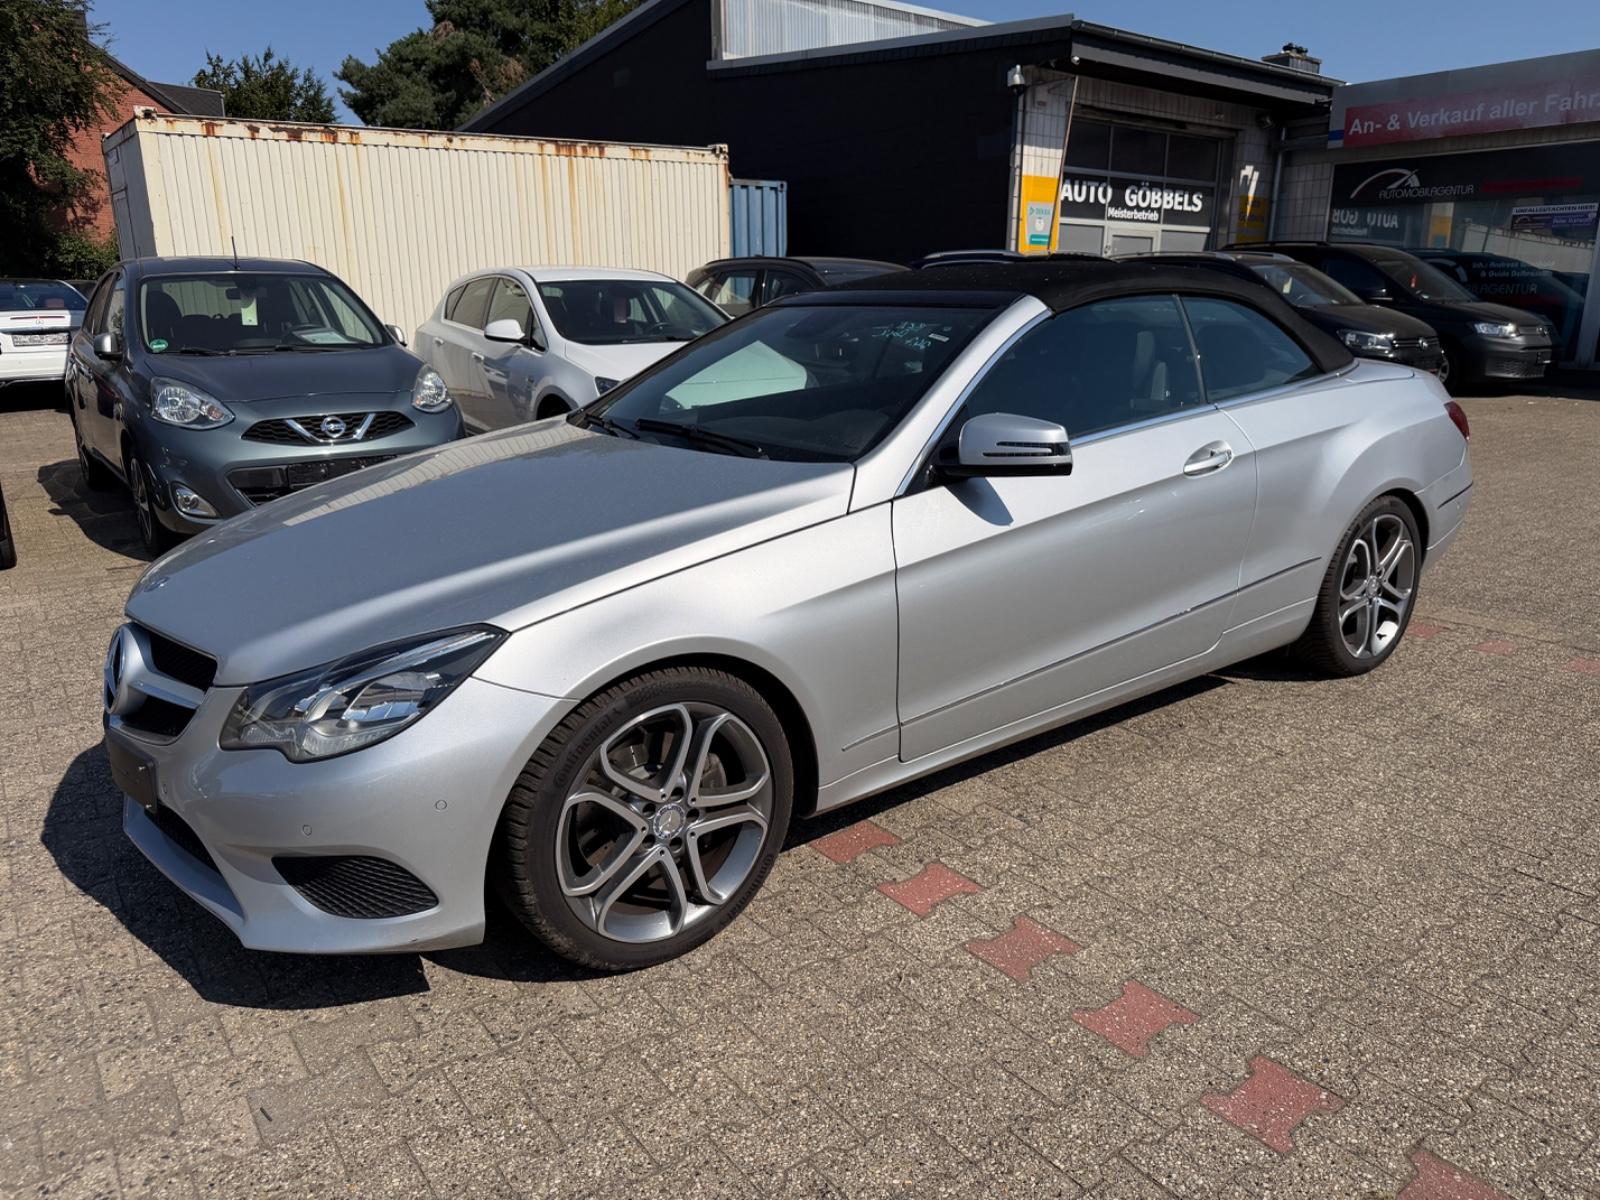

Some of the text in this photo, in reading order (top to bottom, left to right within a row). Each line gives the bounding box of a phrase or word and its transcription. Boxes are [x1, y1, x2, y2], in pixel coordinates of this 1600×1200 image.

[1348, 117, 1381, 136] An-
[1387, 113, 1401, 131] &
[1407, 102, 1484, 129] Verkauf
[1489, 99, 1538, 120] aller
[1060, 178, 1203, 212] AUTO GÖBBELS
[1378, 184, 1474, 200] AUTOMOBILAGENTUR
[1107, 206, 1160, 222] Meisterbetrieb
[553, 714, 613, 789] Continental
